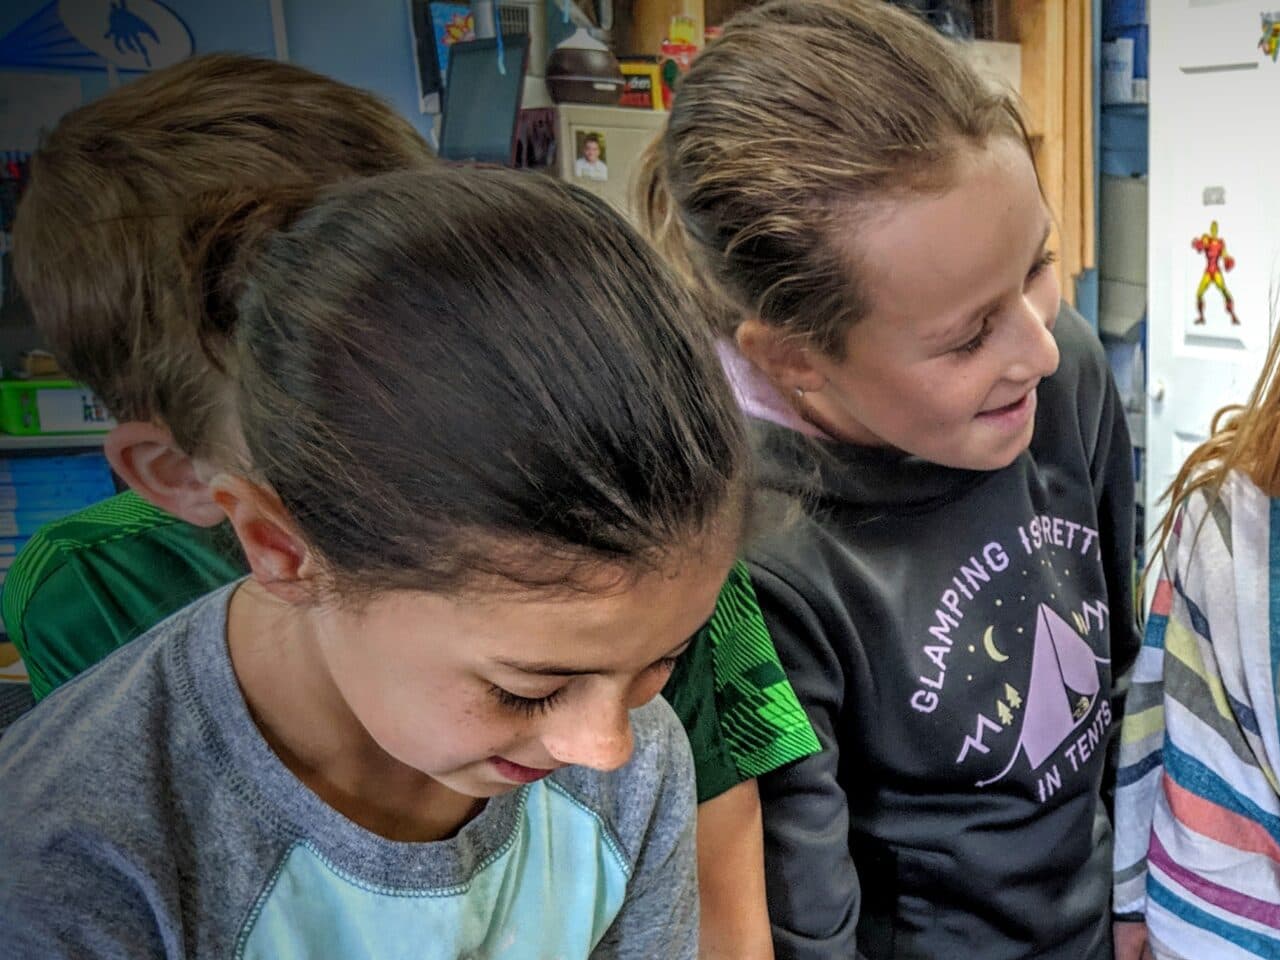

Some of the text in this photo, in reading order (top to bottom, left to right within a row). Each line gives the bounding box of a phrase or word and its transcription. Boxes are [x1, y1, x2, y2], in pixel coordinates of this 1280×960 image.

[911, 541, 1010, 714] GLAMPING
[1040, 515, 1101, 562] RETT
[1038, 699, 1112, 802] IN TENTS
